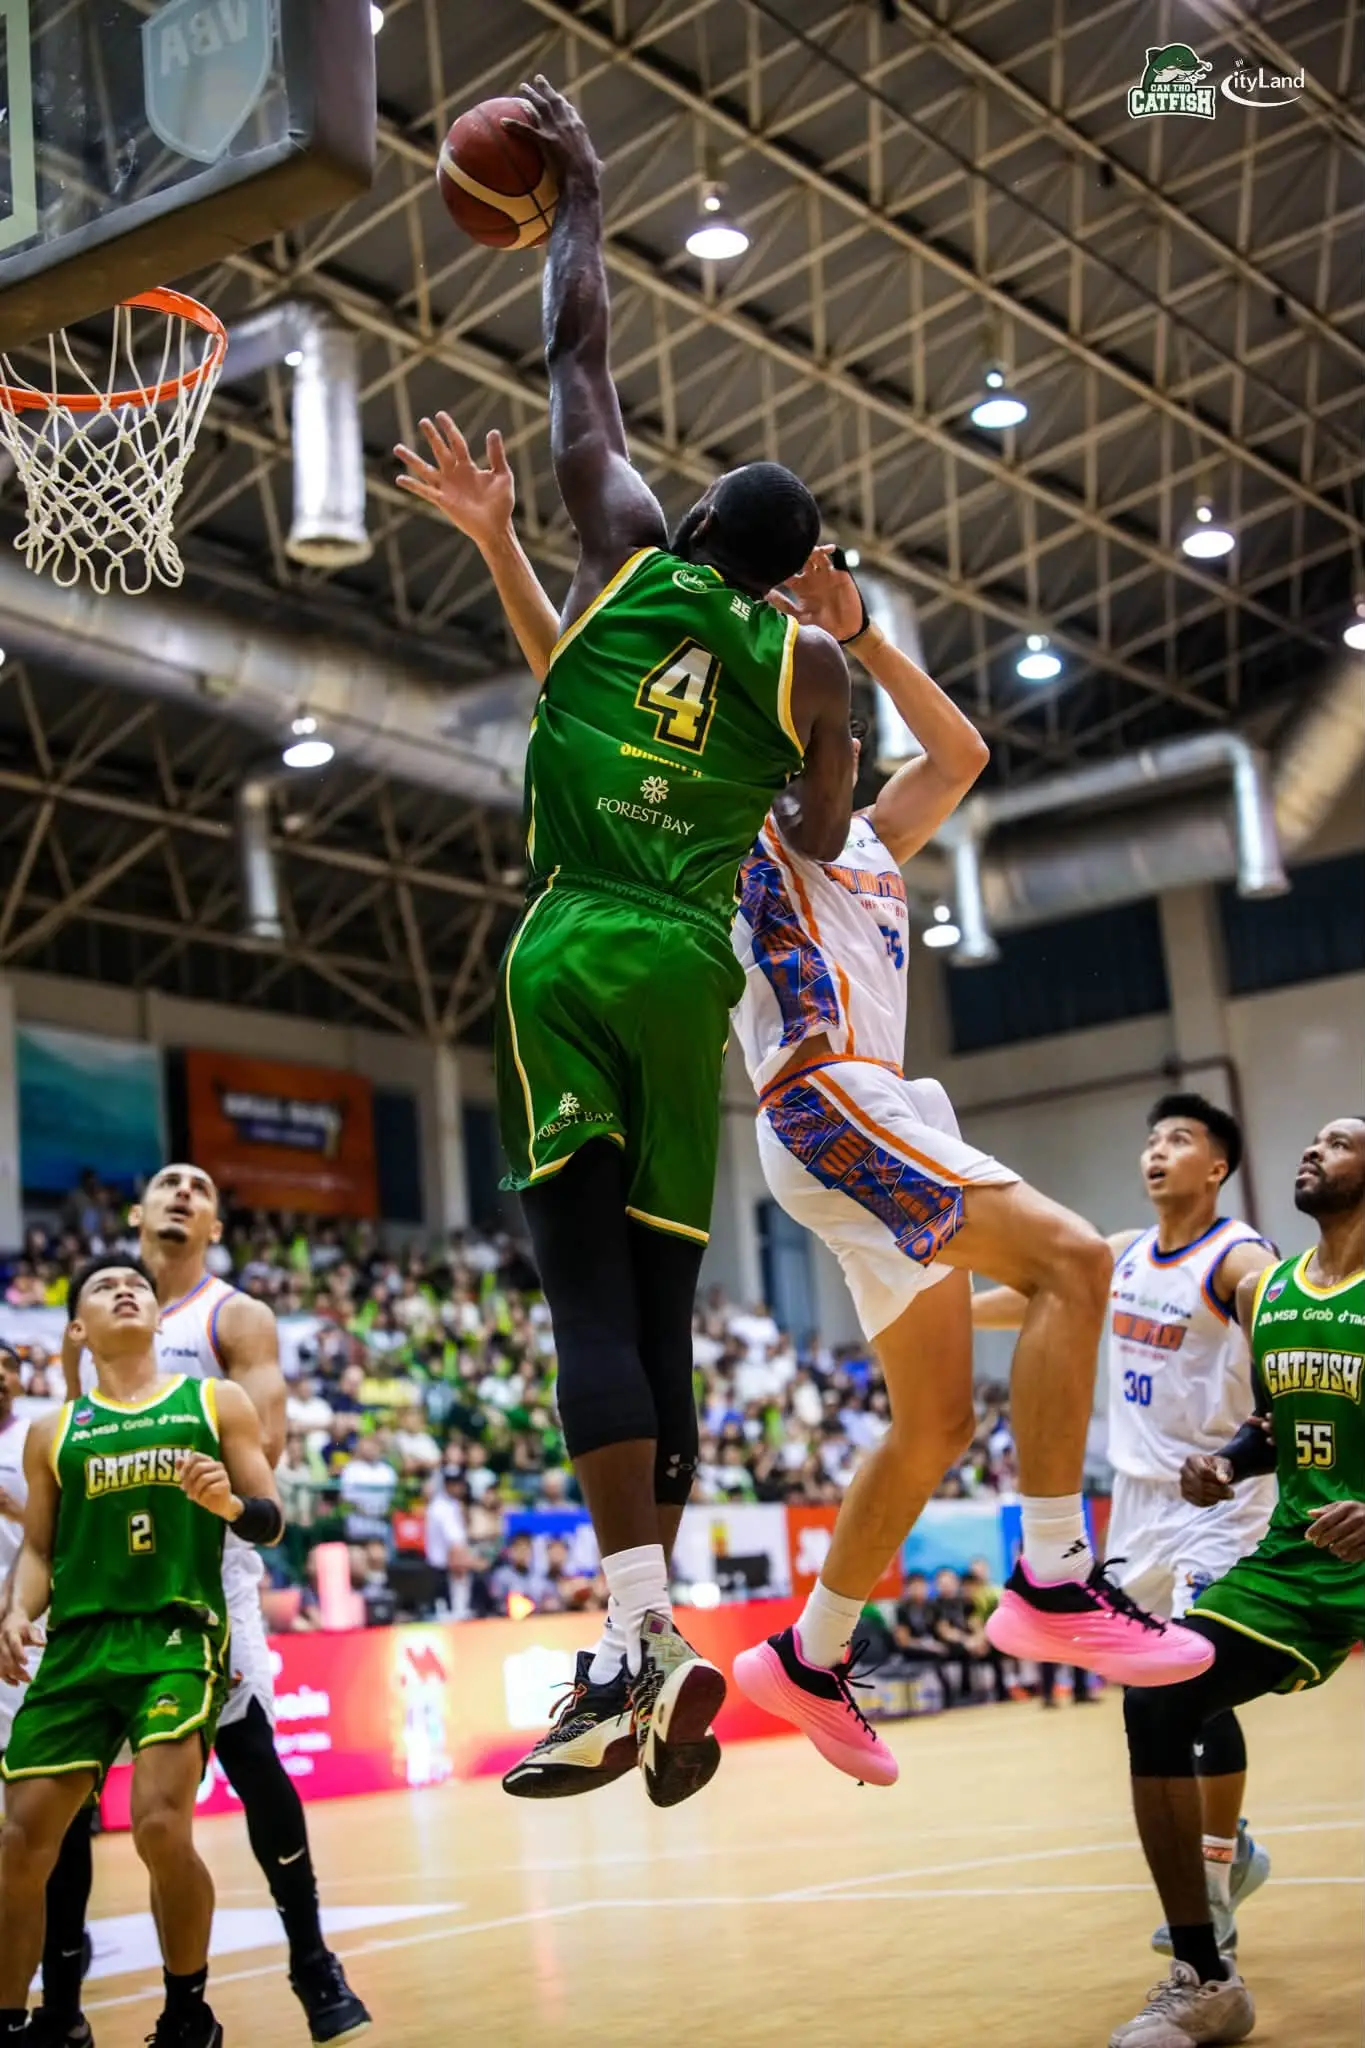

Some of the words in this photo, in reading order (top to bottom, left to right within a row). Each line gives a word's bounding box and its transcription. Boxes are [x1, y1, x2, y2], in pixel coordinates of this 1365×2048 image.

[637, 639, 720, 752] 4
[596, 797, 661, 825] FOREST
[662, 815, 695, 835] BAY
[584, 1111, 614, 1122] BAY
[1273, 1309, 1298, 1321] MSB
[1302, 1307, 1334, 1321] Grab
[1123, 1369, 1153, 1407] 30
[1264, 1350, 1363, 1400] CATFISH
[1295, 1422, 1333, 1467] 55
[130, 1512, 154, 1553] 2
